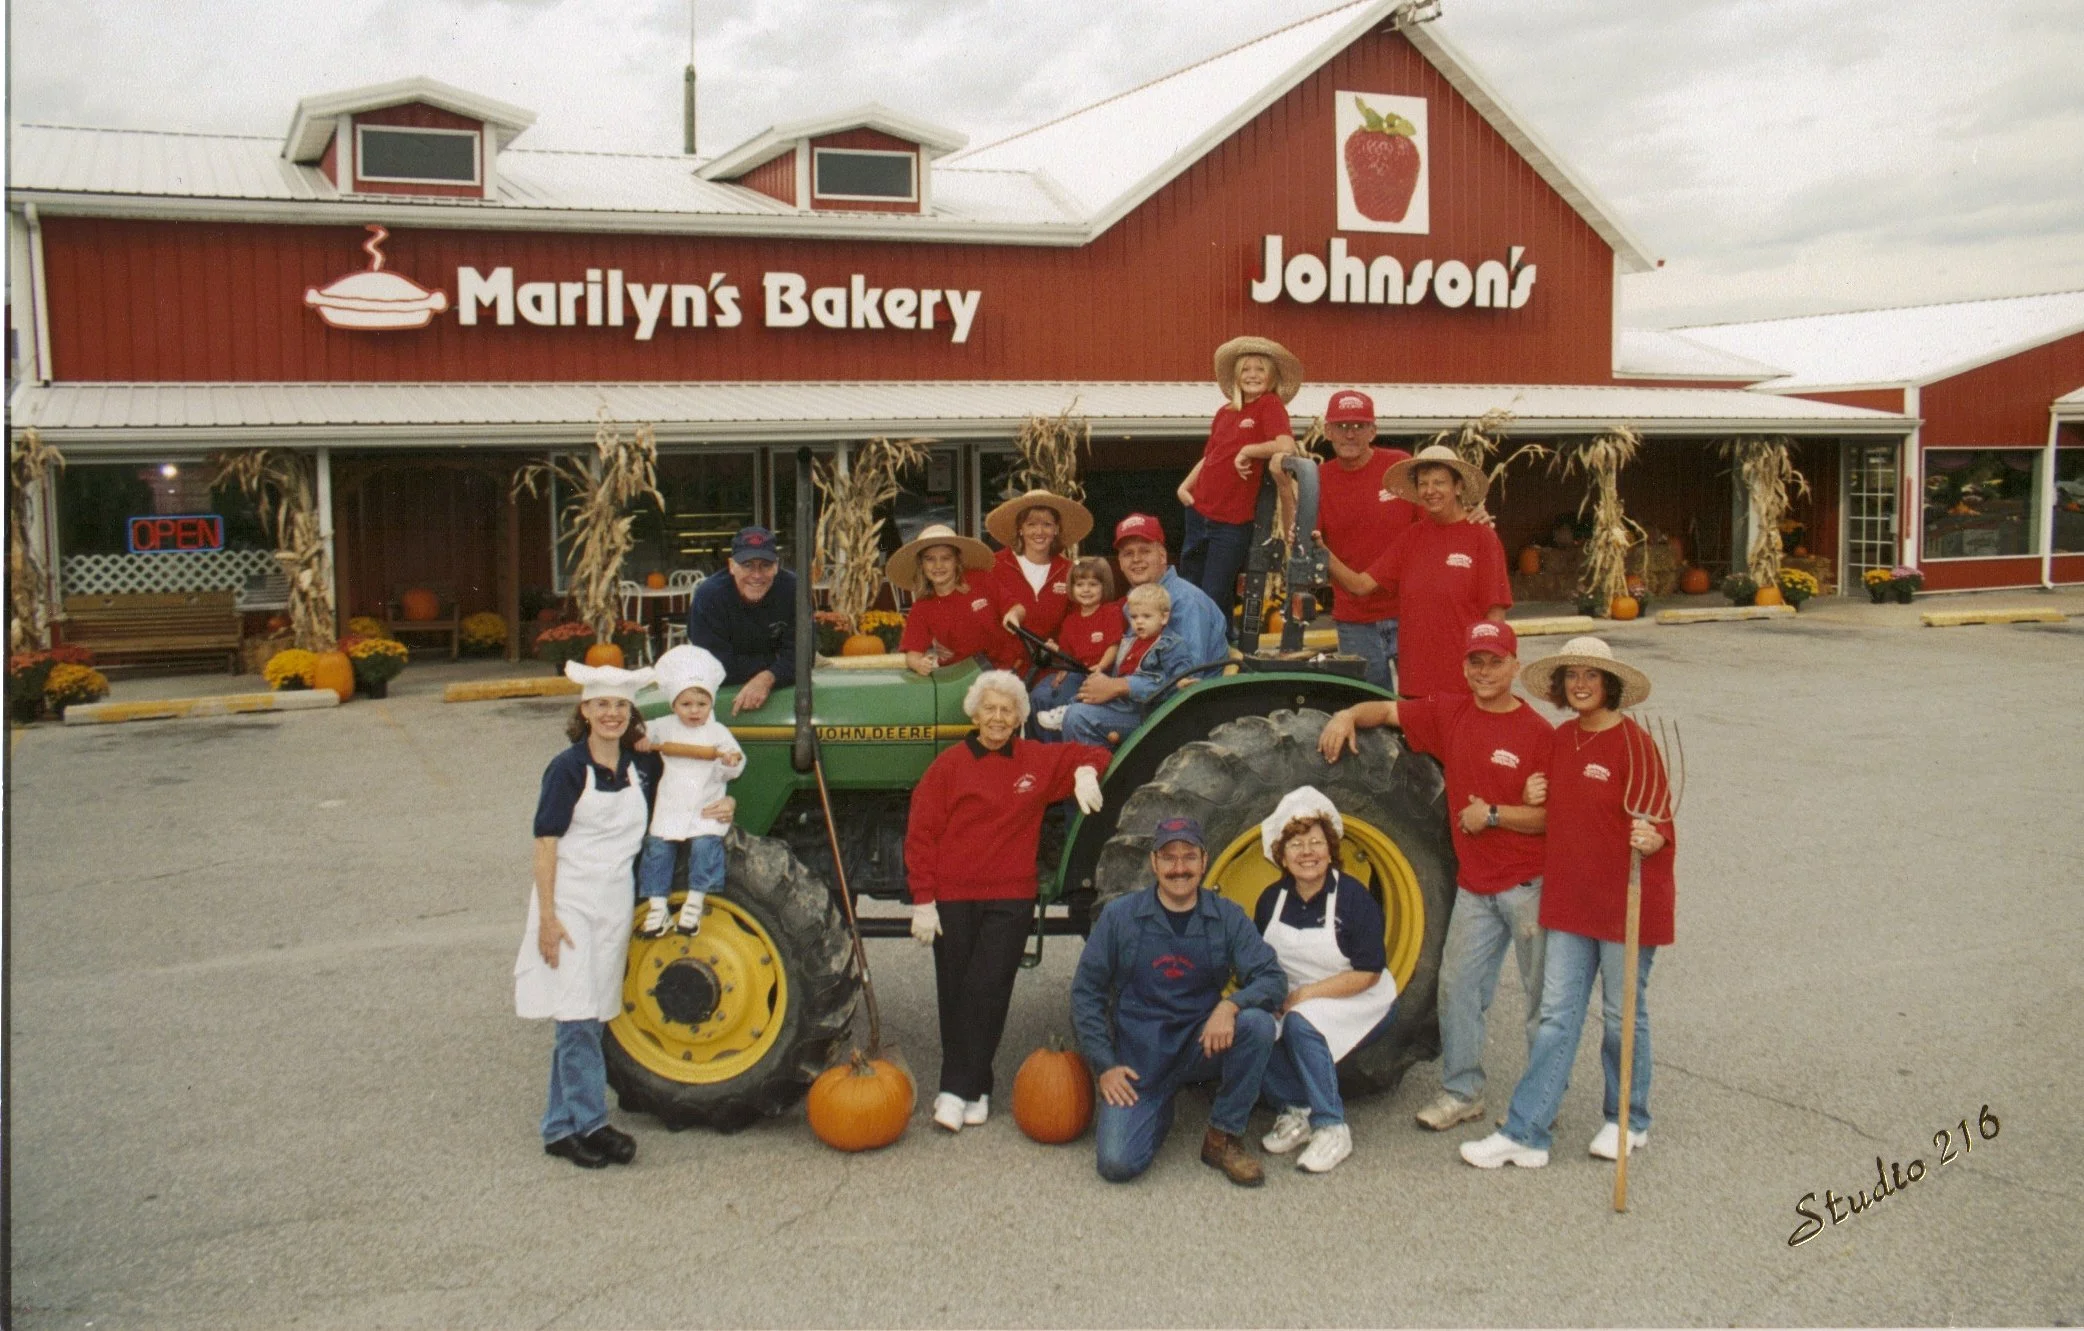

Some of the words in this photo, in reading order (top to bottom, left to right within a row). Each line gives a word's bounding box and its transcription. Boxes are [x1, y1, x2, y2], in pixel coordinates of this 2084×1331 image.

[1251, 234, 1537, 309] Johnson's
[457, 266, 743, 341] Marilyn's
[762, 271, 982, 344] Bakery
[132, 517, 220, 551] OPEN
[816, 727, 866, 740] JOHN
[872, 727, 932, 740] DEERE
